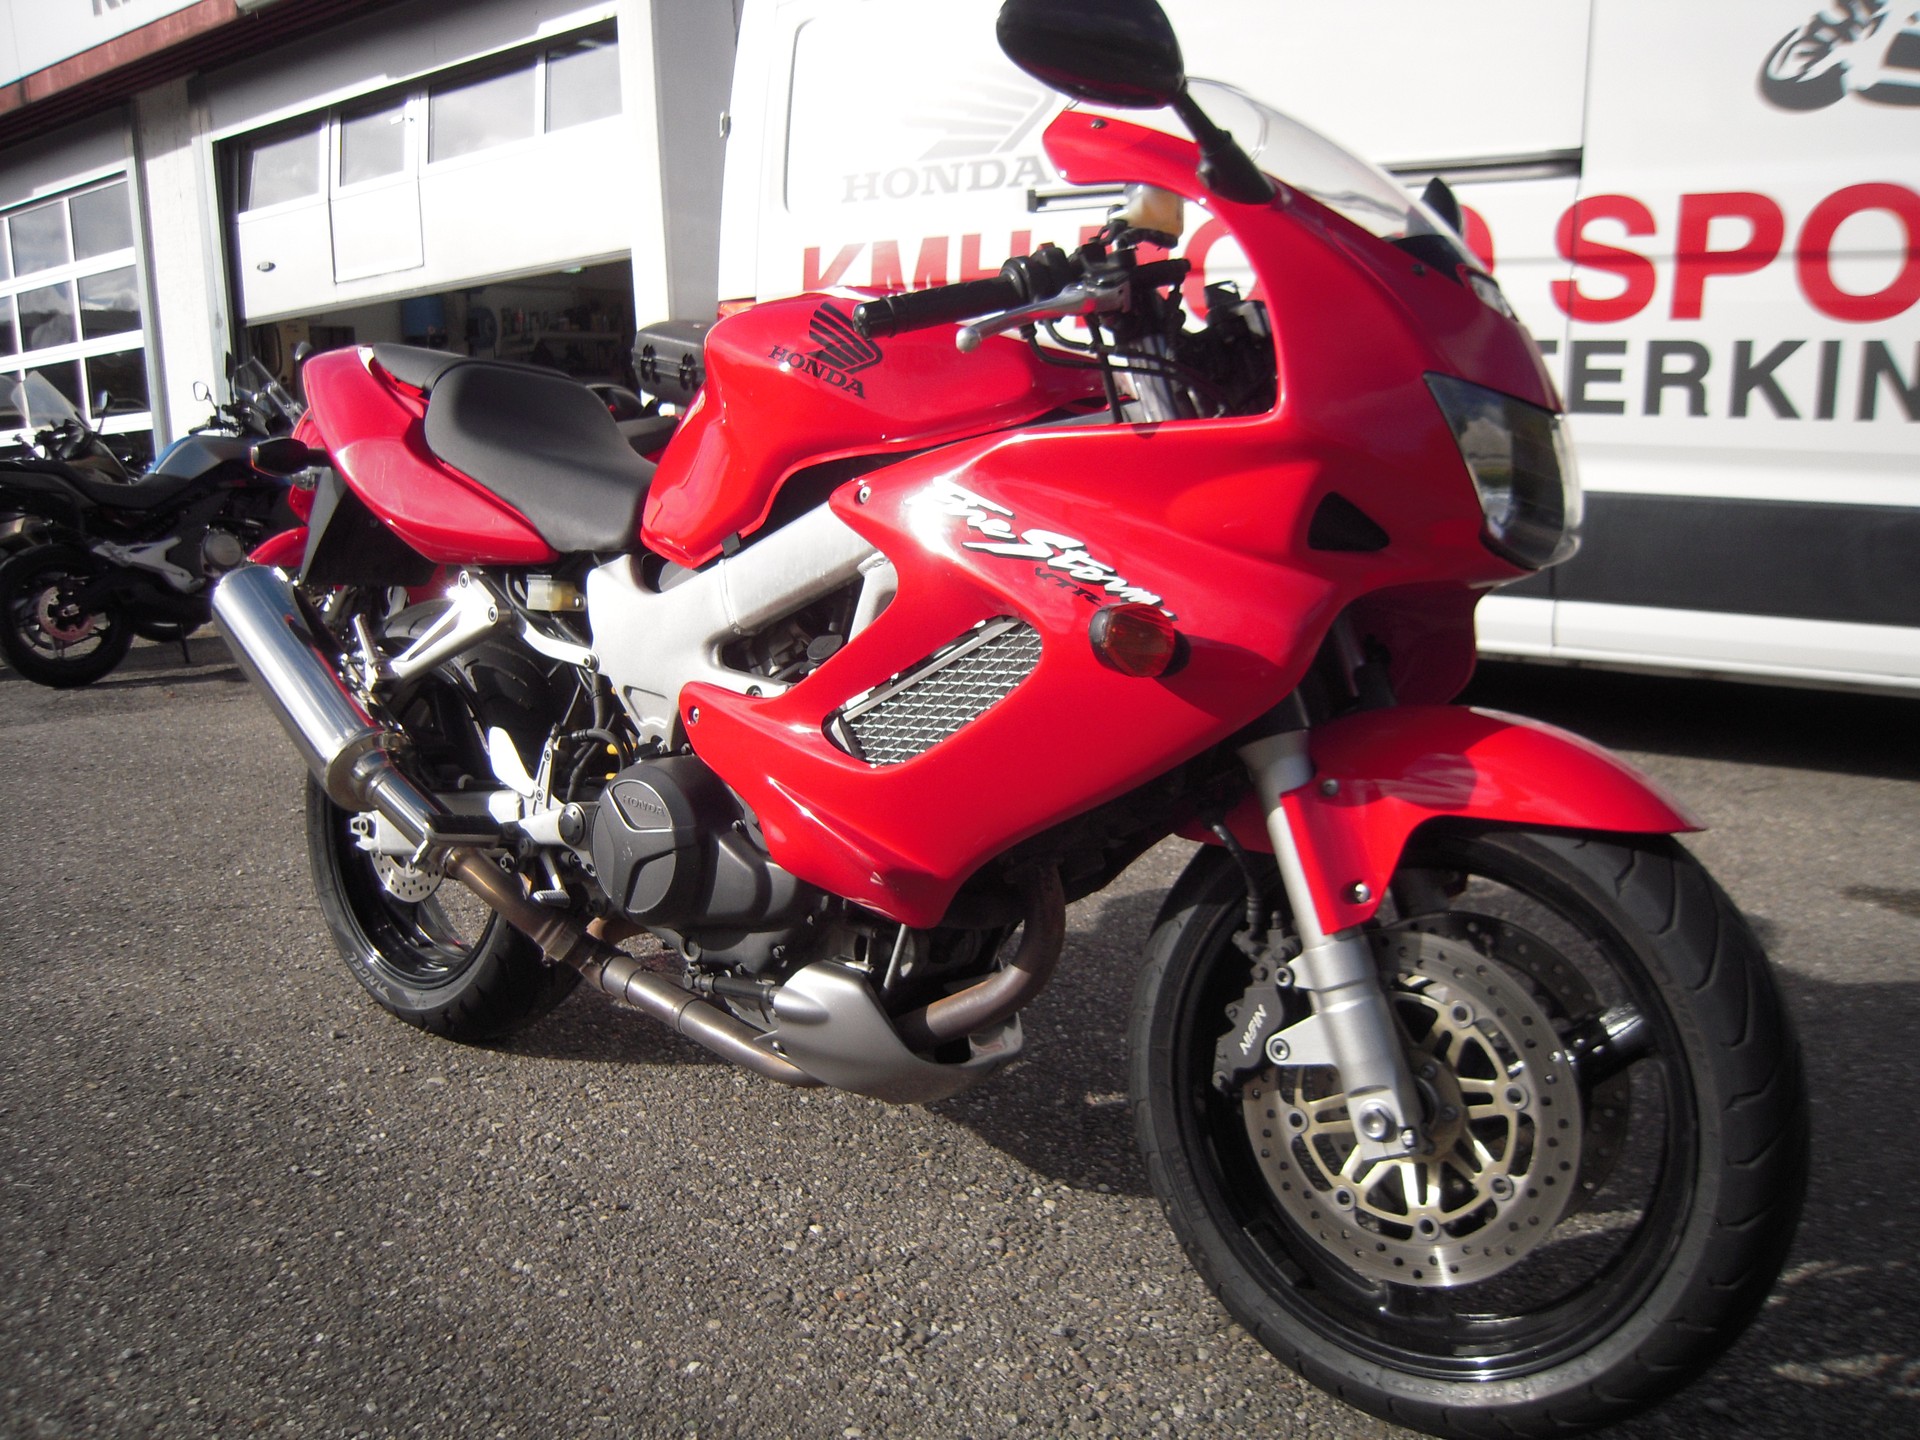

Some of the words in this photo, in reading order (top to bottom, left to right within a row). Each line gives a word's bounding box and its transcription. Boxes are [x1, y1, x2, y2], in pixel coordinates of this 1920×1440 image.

[841, 155, 1052, 204] HONDA
[768, 344, 866, 400] HONDA
[1535, 340, 1920, 423] ERKIN
[622, 793, 667, 818] HONDA
